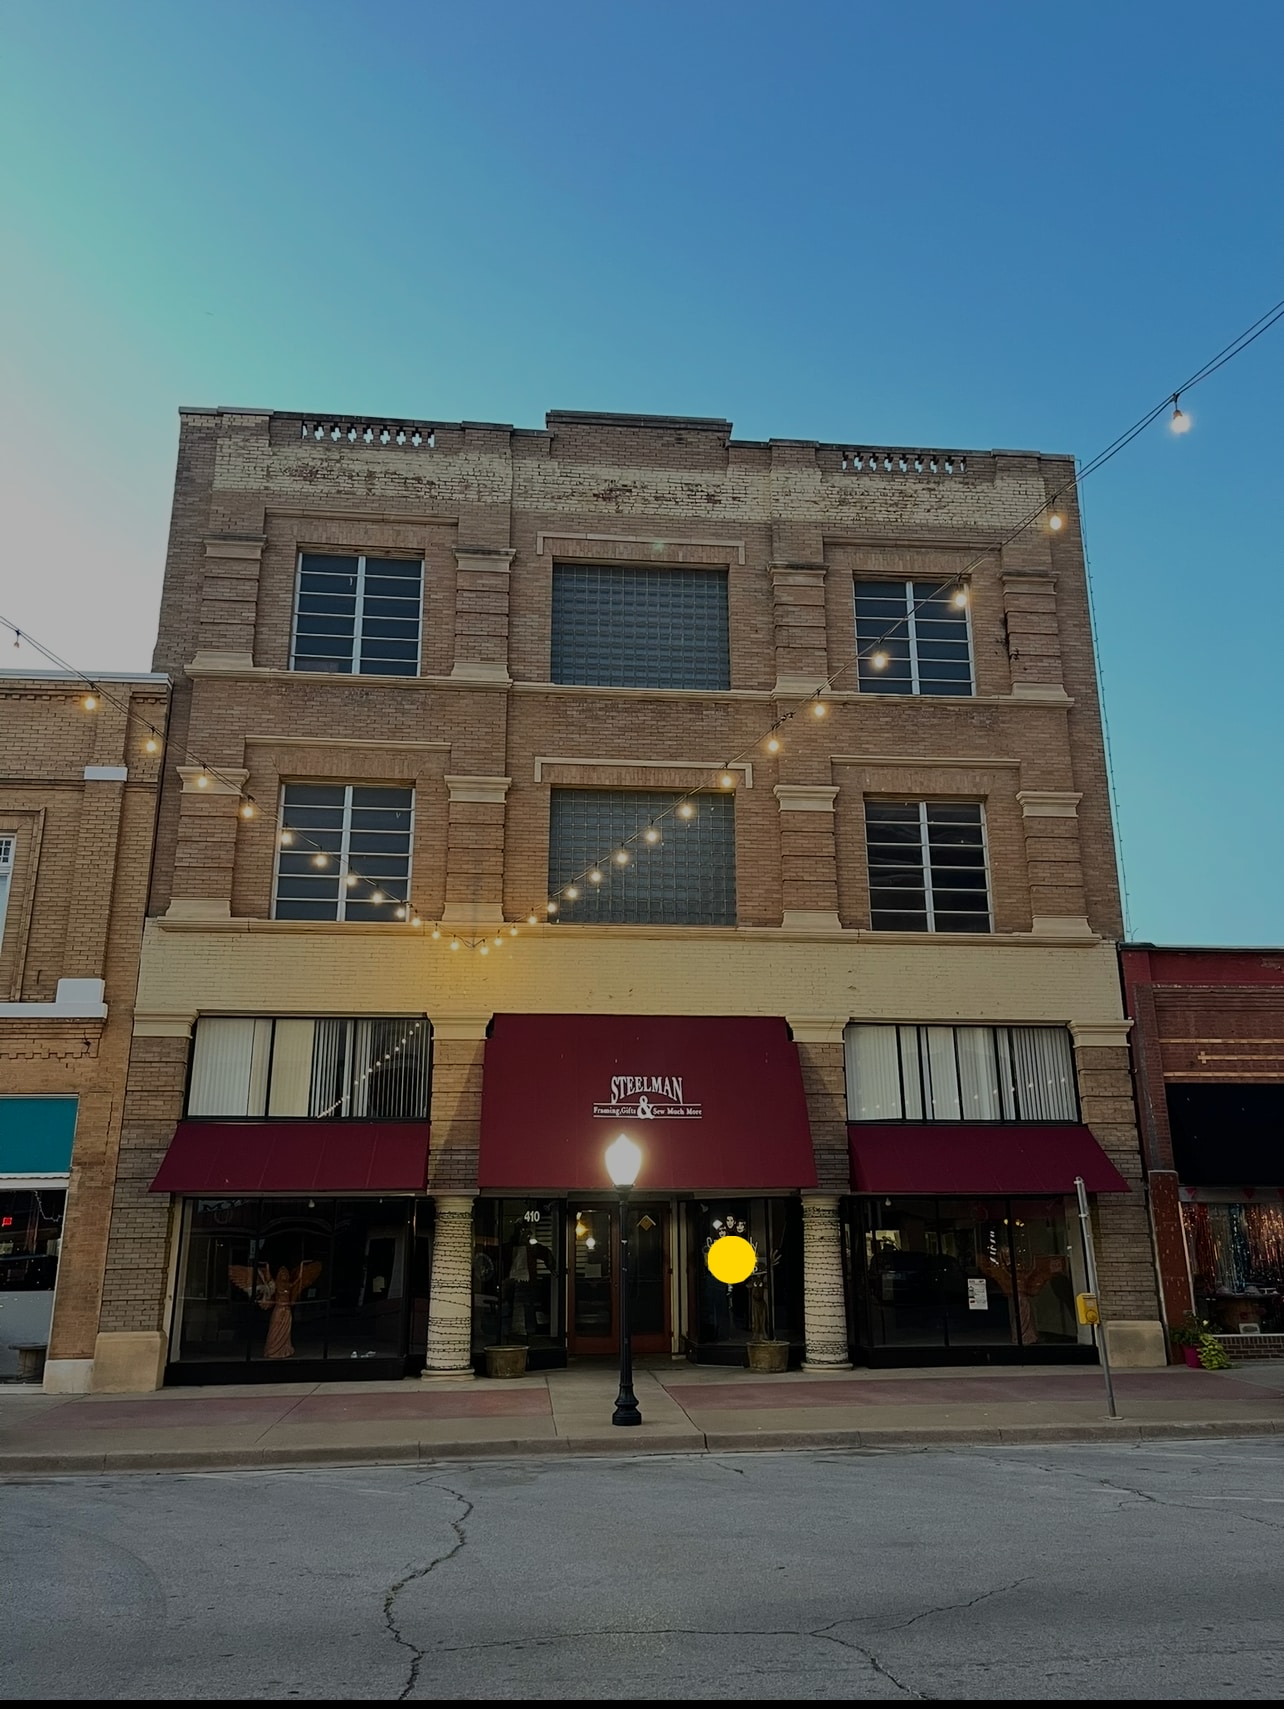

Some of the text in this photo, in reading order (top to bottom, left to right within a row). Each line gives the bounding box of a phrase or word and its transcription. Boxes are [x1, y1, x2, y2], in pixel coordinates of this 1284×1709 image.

[611, 1076, 683, 1104] STEELMAN
[637, 1095, 655, 1119] &
[524, 1210, 540, 1222] 410
